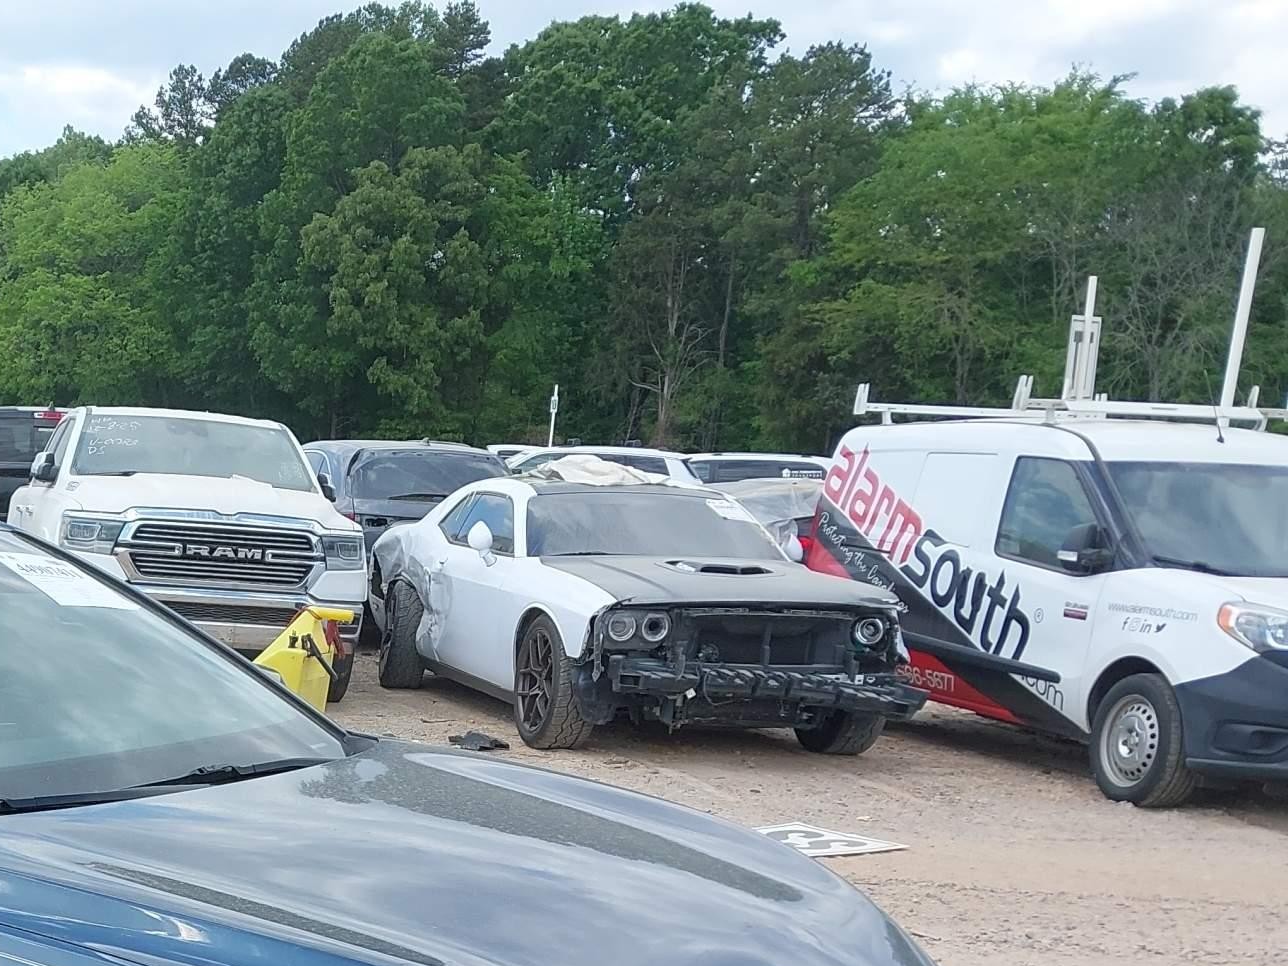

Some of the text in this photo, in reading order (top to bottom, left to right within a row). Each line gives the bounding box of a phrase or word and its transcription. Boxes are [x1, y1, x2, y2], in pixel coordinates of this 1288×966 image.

[185, 544, 263, 560] RAM
[818, 511, 853, 564] Protecting
[854, 551, 867, 572] the
